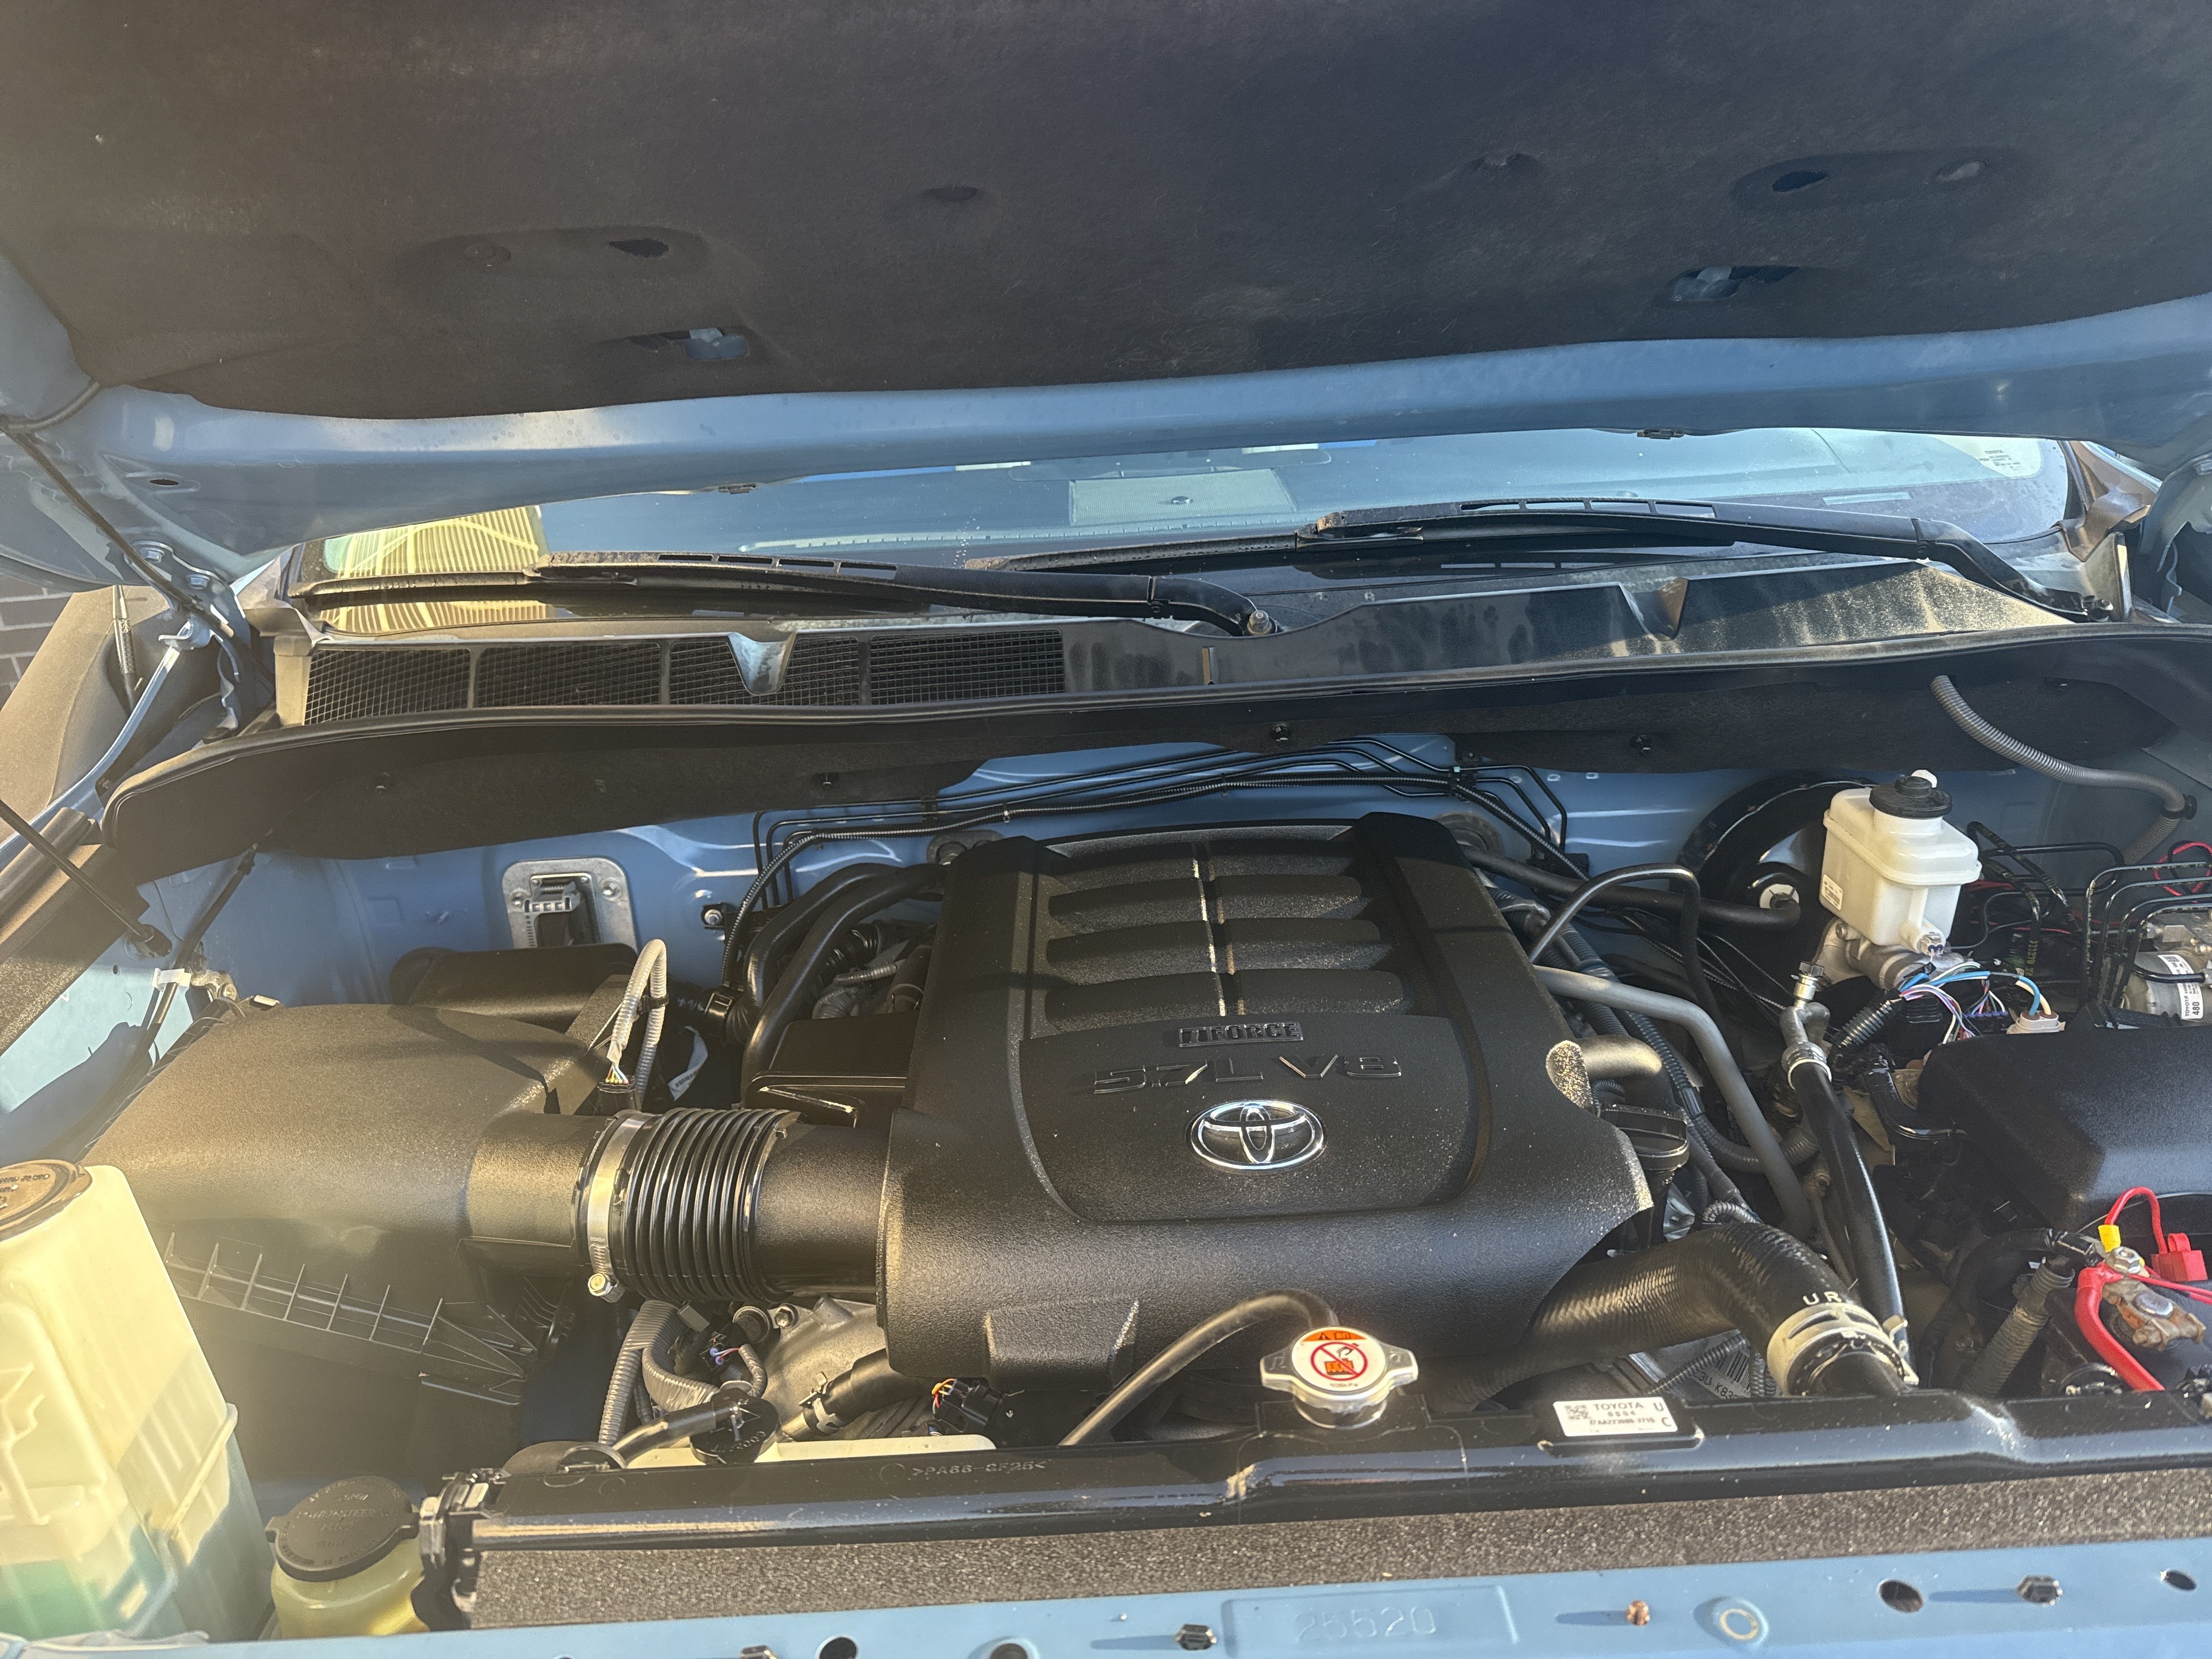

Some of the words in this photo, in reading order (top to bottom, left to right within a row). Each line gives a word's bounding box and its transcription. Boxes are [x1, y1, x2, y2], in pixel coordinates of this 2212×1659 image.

[1278, 1054, 1402, 1077] V8
[1593, 1402, 1644, 1410] TOYOTA
[1291, 1607, 1437, 1643] 25520
